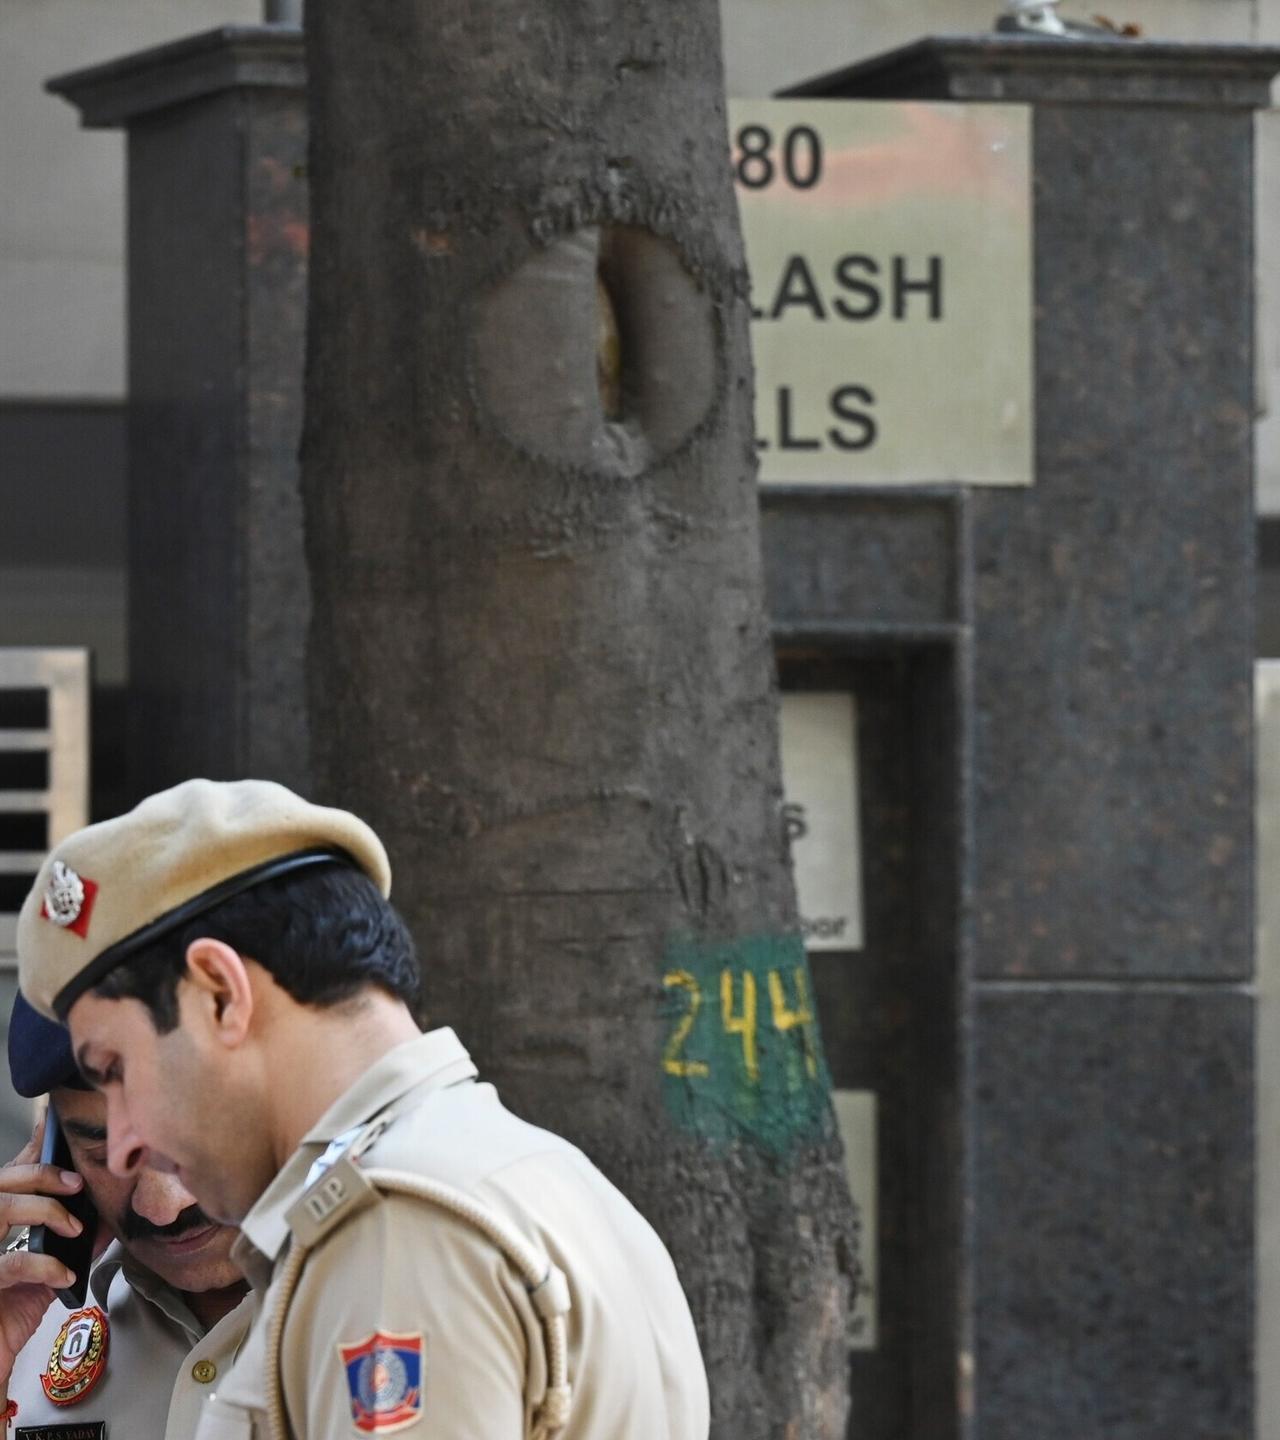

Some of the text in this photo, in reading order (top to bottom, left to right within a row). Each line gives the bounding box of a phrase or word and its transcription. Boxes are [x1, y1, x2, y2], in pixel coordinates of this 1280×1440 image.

[734, 124, 823, 190] 80
[661, 967, 817, 1082] 244
[65, 1428, 97, 1440] YADAV
